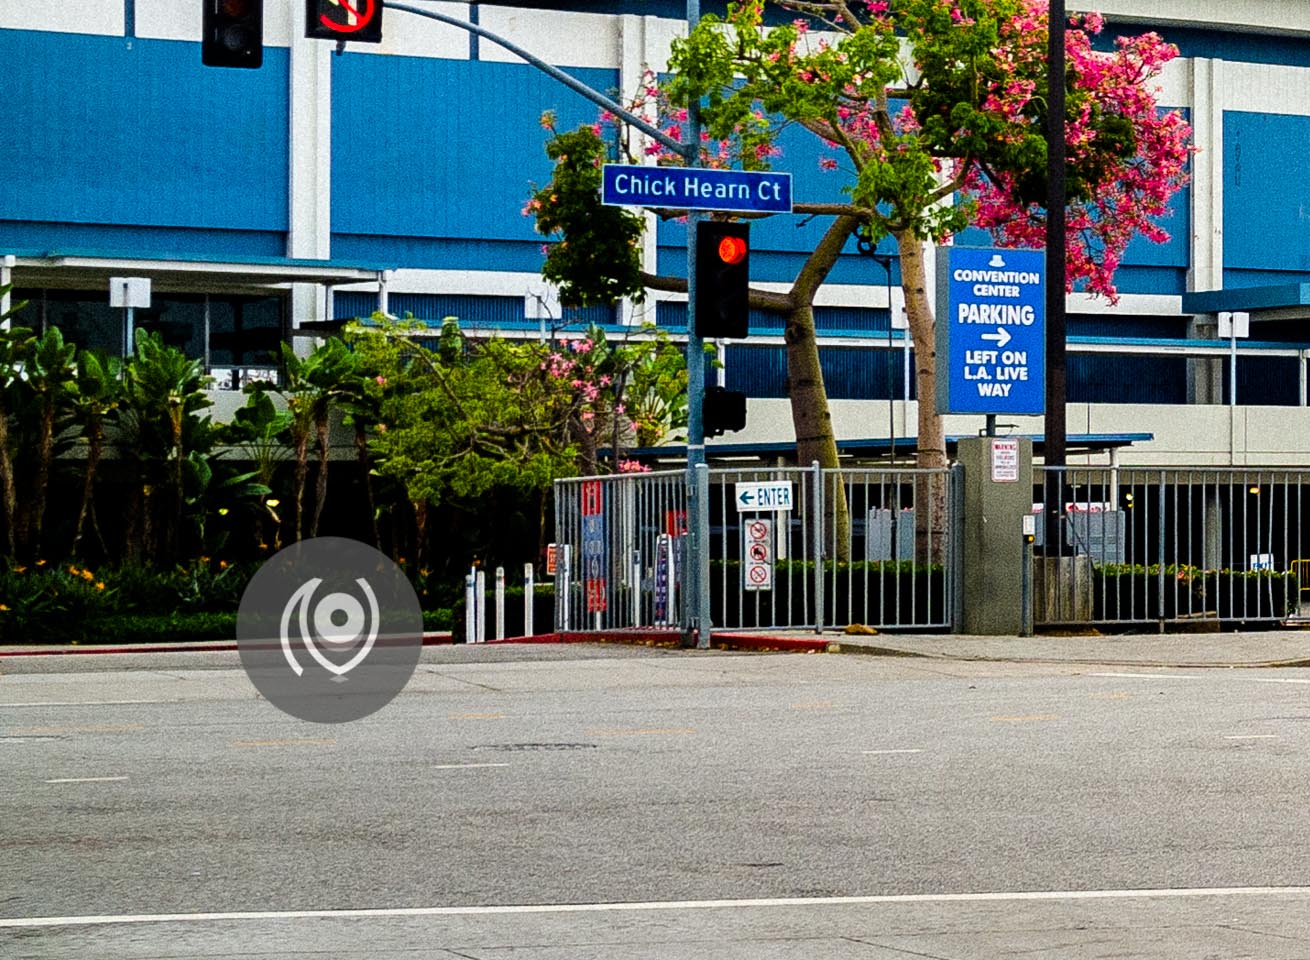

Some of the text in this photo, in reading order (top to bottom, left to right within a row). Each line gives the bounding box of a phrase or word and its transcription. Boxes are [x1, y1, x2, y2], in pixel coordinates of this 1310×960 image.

[615, 173, 781, 201] Chick Hearn Ct
[953, 269, 1040, 284] CONVENTION
[973, 284, 1020, 297] CENTER
[958, 303, 1035, 326] PARKING
[965, 350, 1027, 365] LEFT ON
[964, 366, 1028, 381] L.A. LIVE
[977, 383, 1012, 397] WAY
[757, 487, 790, 506] ENTER
